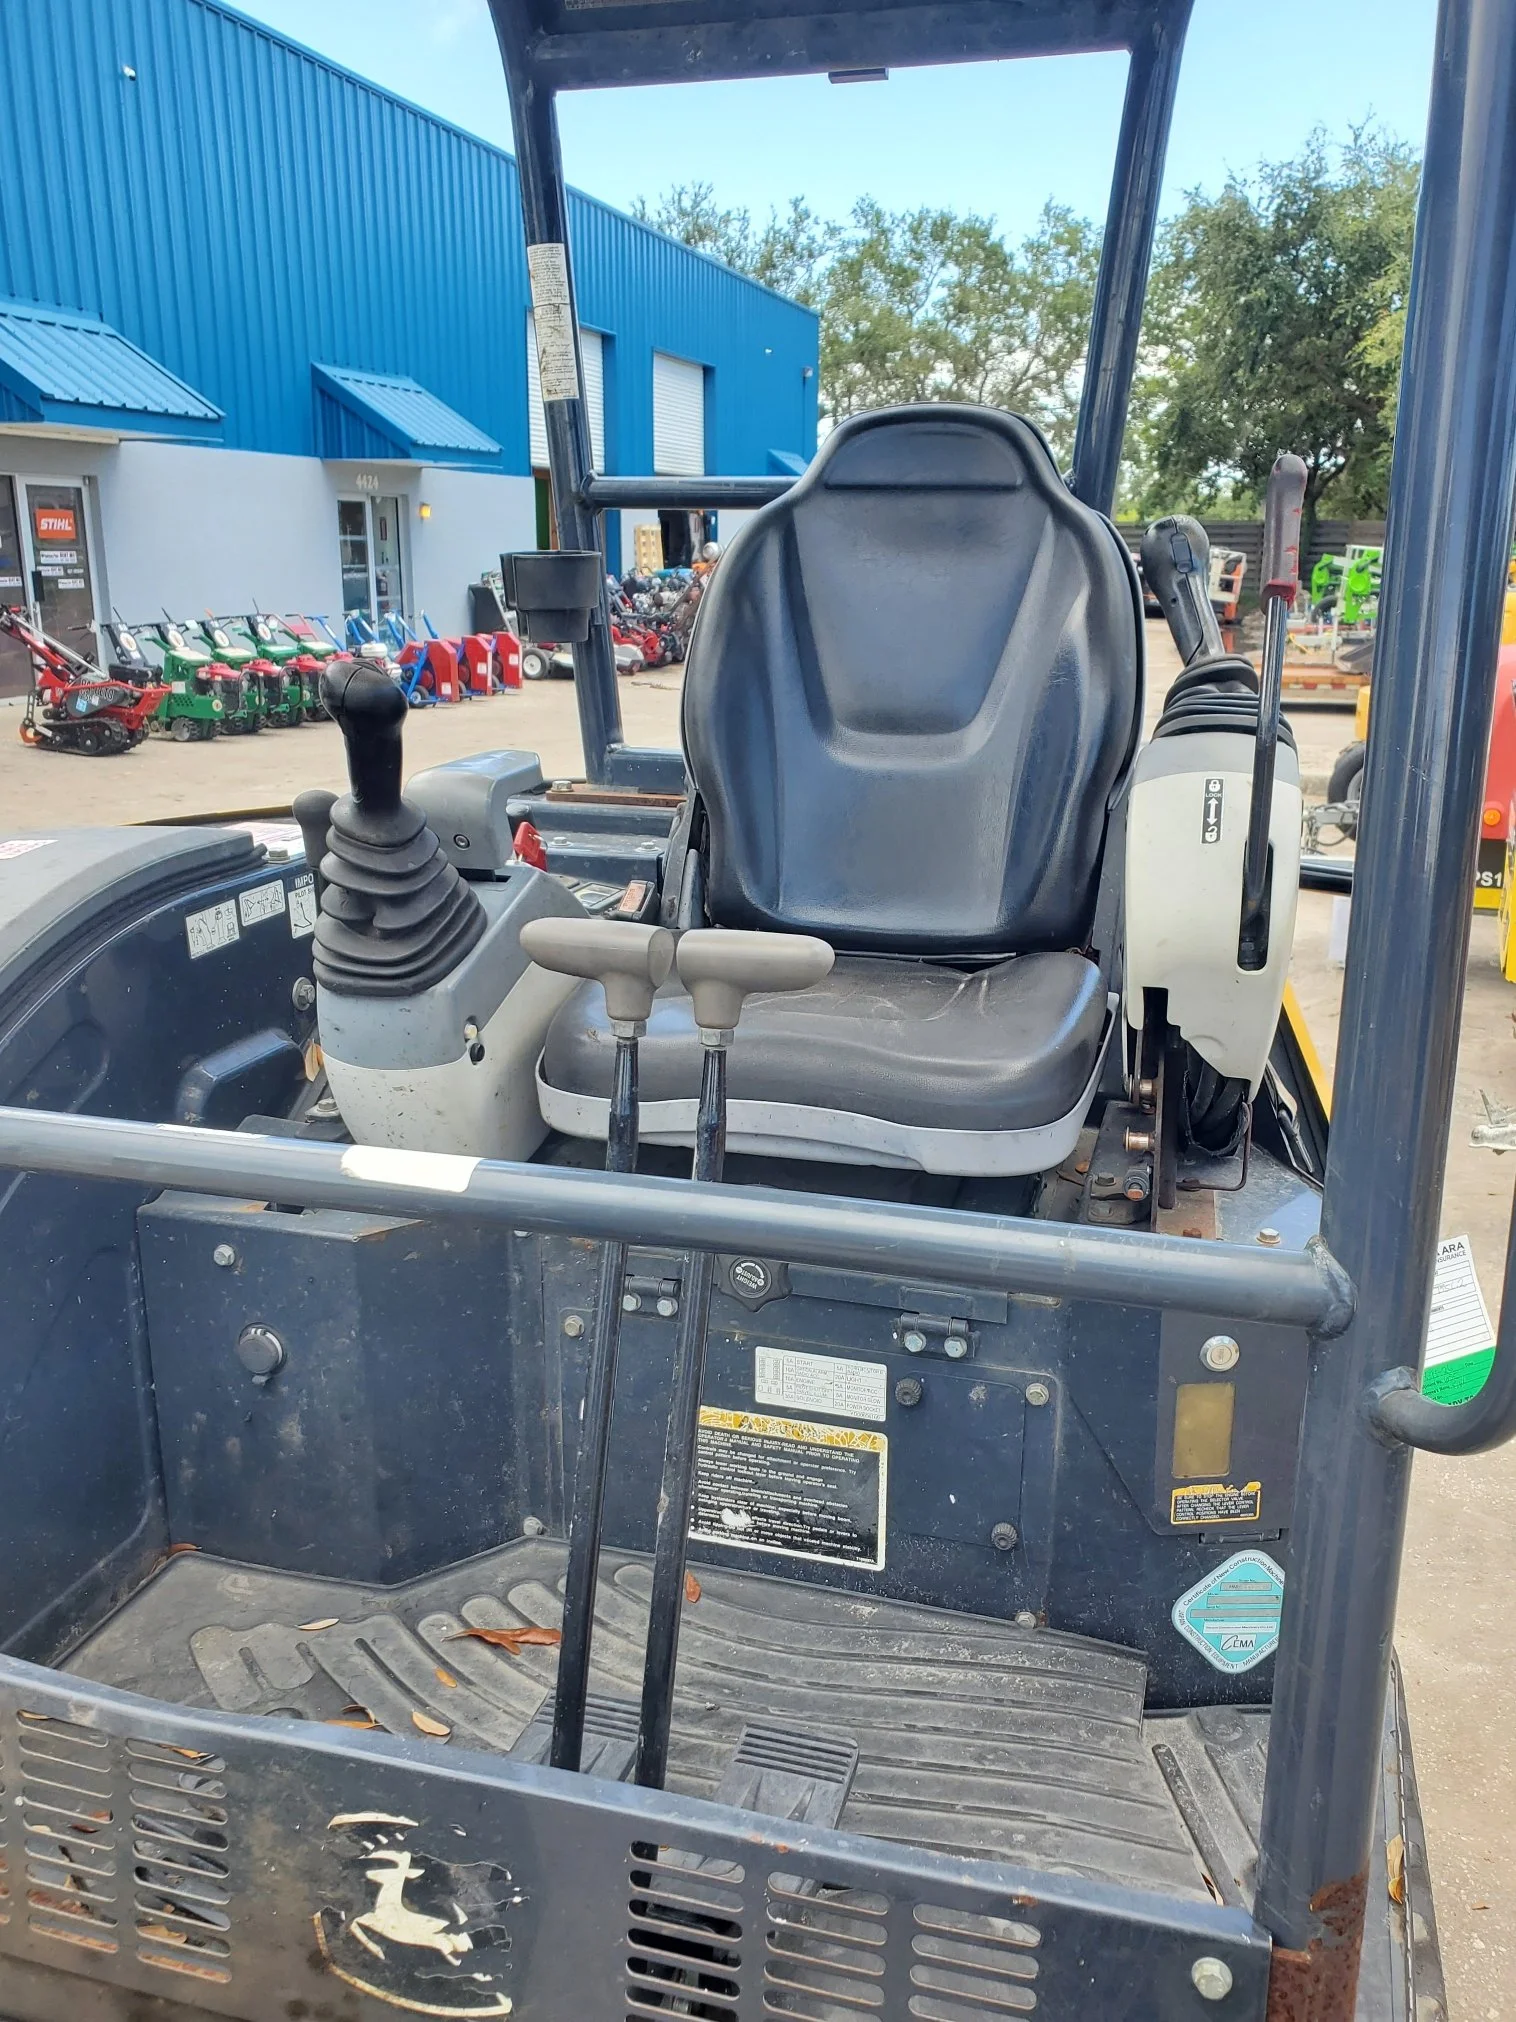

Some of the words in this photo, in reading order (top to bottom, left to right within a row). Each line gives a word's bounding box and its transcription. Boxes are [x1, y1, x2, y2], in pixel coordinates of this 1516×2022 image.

[40, 517, 72, 530] STIHL
[295, 873, 314, 888] IMPO
[1442, 1241, 1465, 1255] ARA
[1437, 1250, 1467, 1263] SURANCE
[1183, 1583, 1212, 1606] Certificate
[1211, 1576, 1217, 1585] of
[1216, 1569, 1229, 1580] New
[1229, 1557, 1267, 1570] Construction
[1184, 1625, 1212, 1653] CONSTRUCTION
[1211, 1651, 1238, 1670] EQUIPMENT
[1221, 1634, 1254, 1651] CEMA
